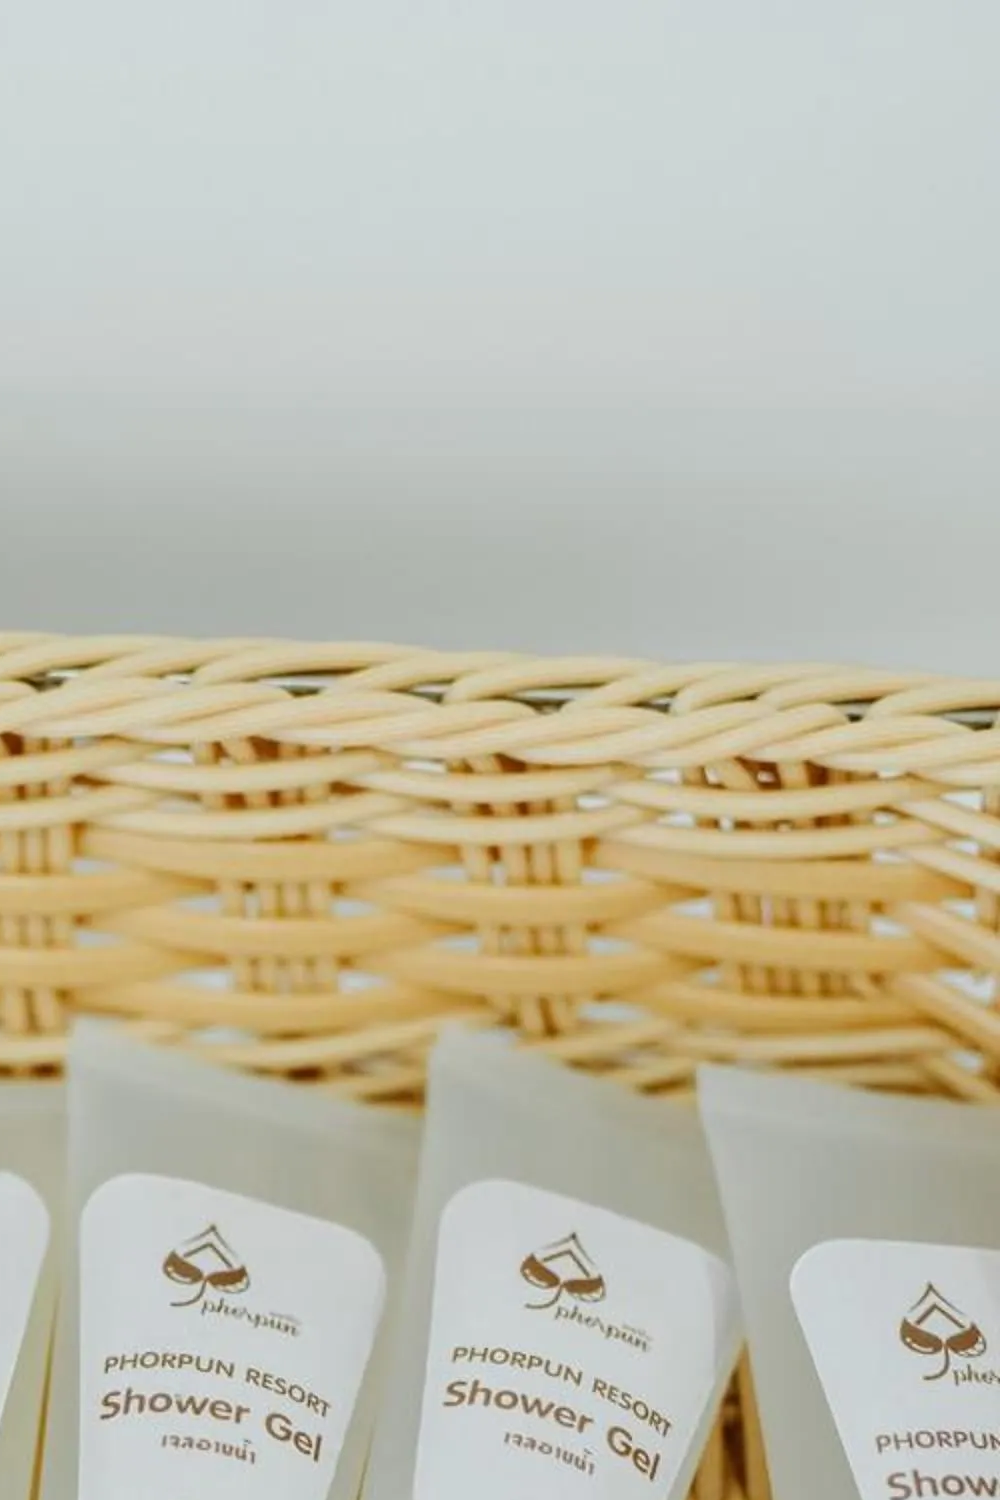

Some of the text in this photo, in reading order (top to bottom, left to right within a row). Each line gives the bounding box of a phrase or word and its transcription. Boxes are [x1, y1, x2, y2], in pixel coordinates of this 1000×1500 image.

[99, 1386, 323, 1463] Shower Gel
[103, 1351, 332, 1418] PHORPUN RESORT
[451, 1346, 674, 1438] PHORPUN RESORT
[442, 1378, 661, 1480] Shower Gel
